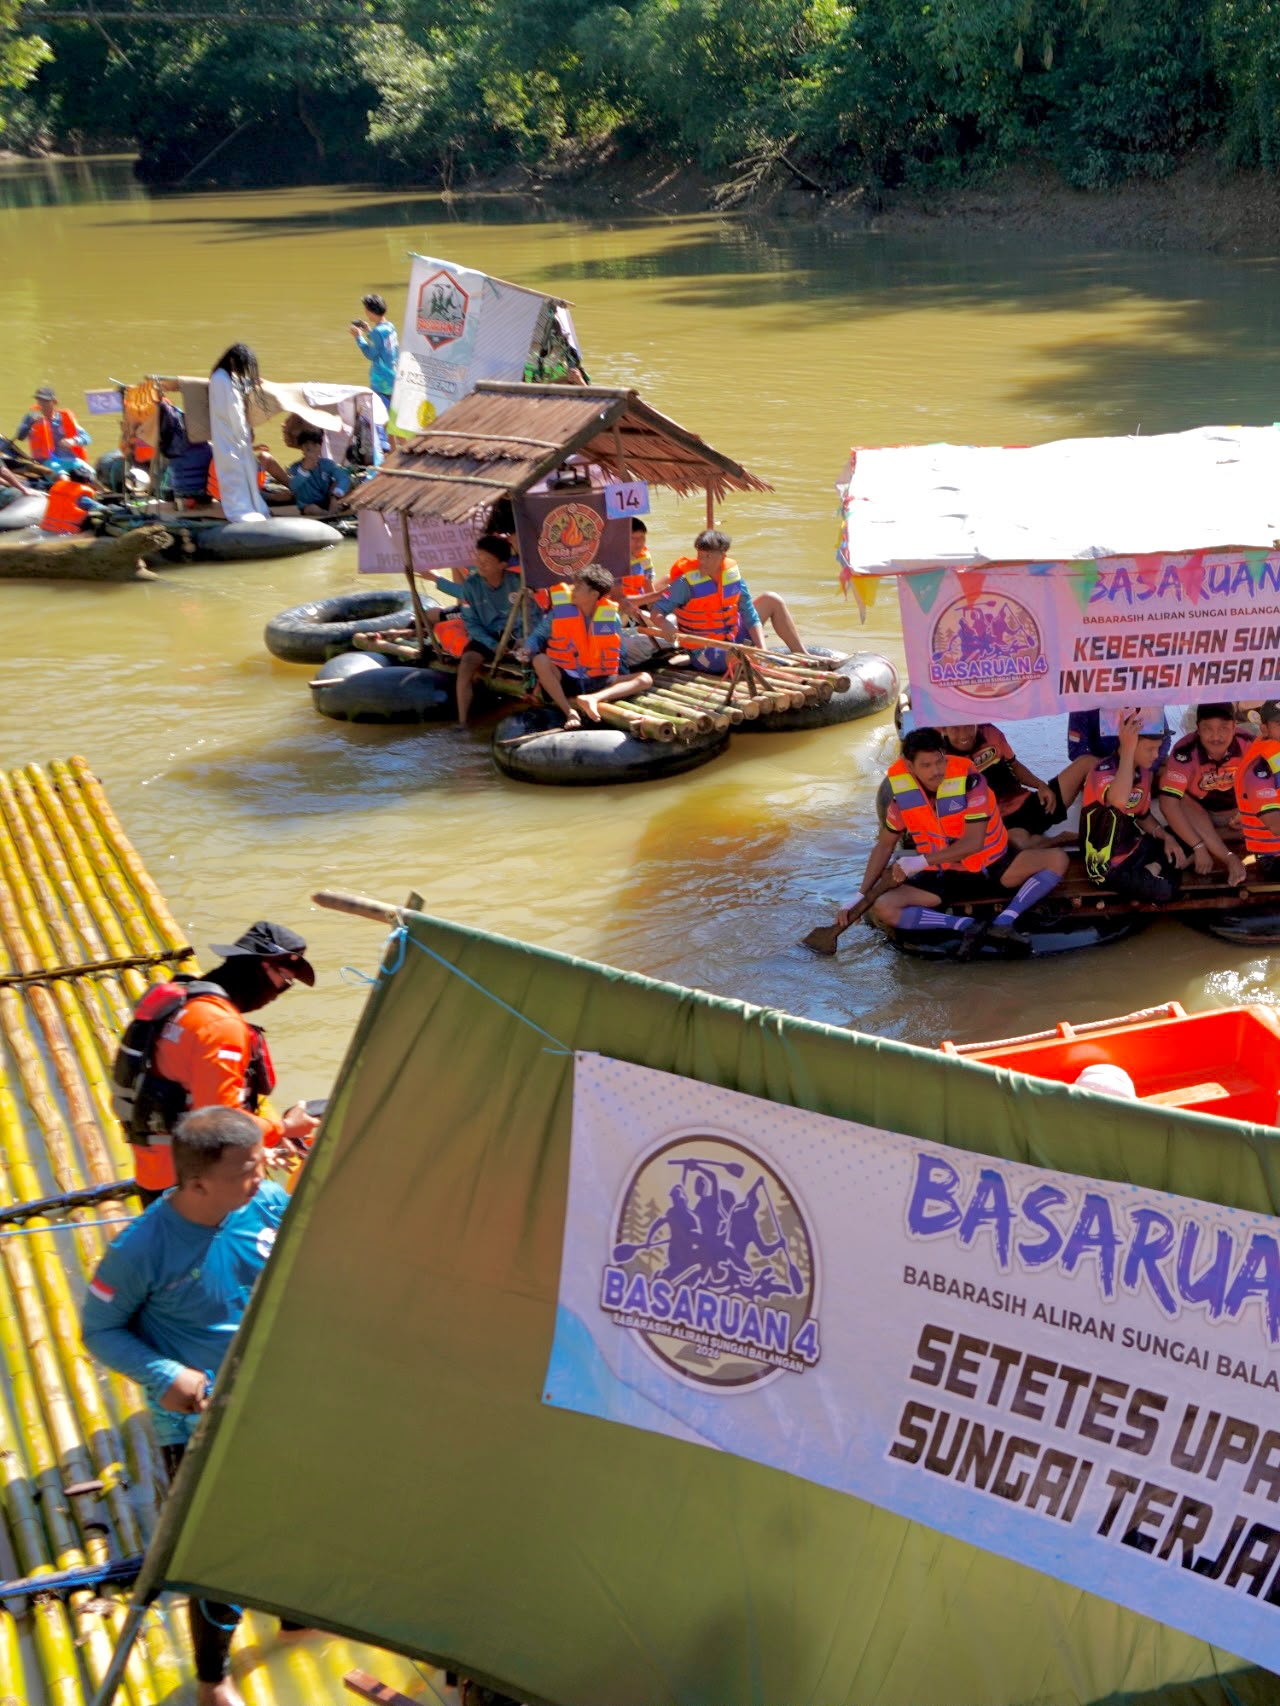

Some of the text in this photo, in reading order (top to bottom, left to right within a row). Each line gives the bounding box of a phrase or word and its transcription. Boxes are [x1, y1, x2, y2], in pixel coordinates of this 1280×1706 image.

[616, 489, 640, 510] 14
[1083, 614, 1144, 624] BABARASIH
[1147, 611, 1185, 620] ALIRAN
[1188, 608, 1227, 618] SUNGAI
[1073, 629, 1228, 662] KEBERSIHAN
[931, 655, 1047, 681] BASARUAN 4
[1059, 664, 1182, 695] INVESTASI
[1187, 659, 1254, 687] MASA
[603, 1268, 820, 1361] BASARUAN 4
[903, 1265, 1026, 1317] BABARASIH
[1032, 1303, 1115, 1342] ALIRAN
[1121, 1327, 1209, 1370] SUNGAI
[672, 1327, 709, 1345] ALIRAN
[710, 1336, 748, 1355] SUNGAI
[749, 1346, 804, 1371] BALANGAN
[910, 1323, 1169, 1456] SETETES
[888, 1400, 1094, 1523] SUNGAI
